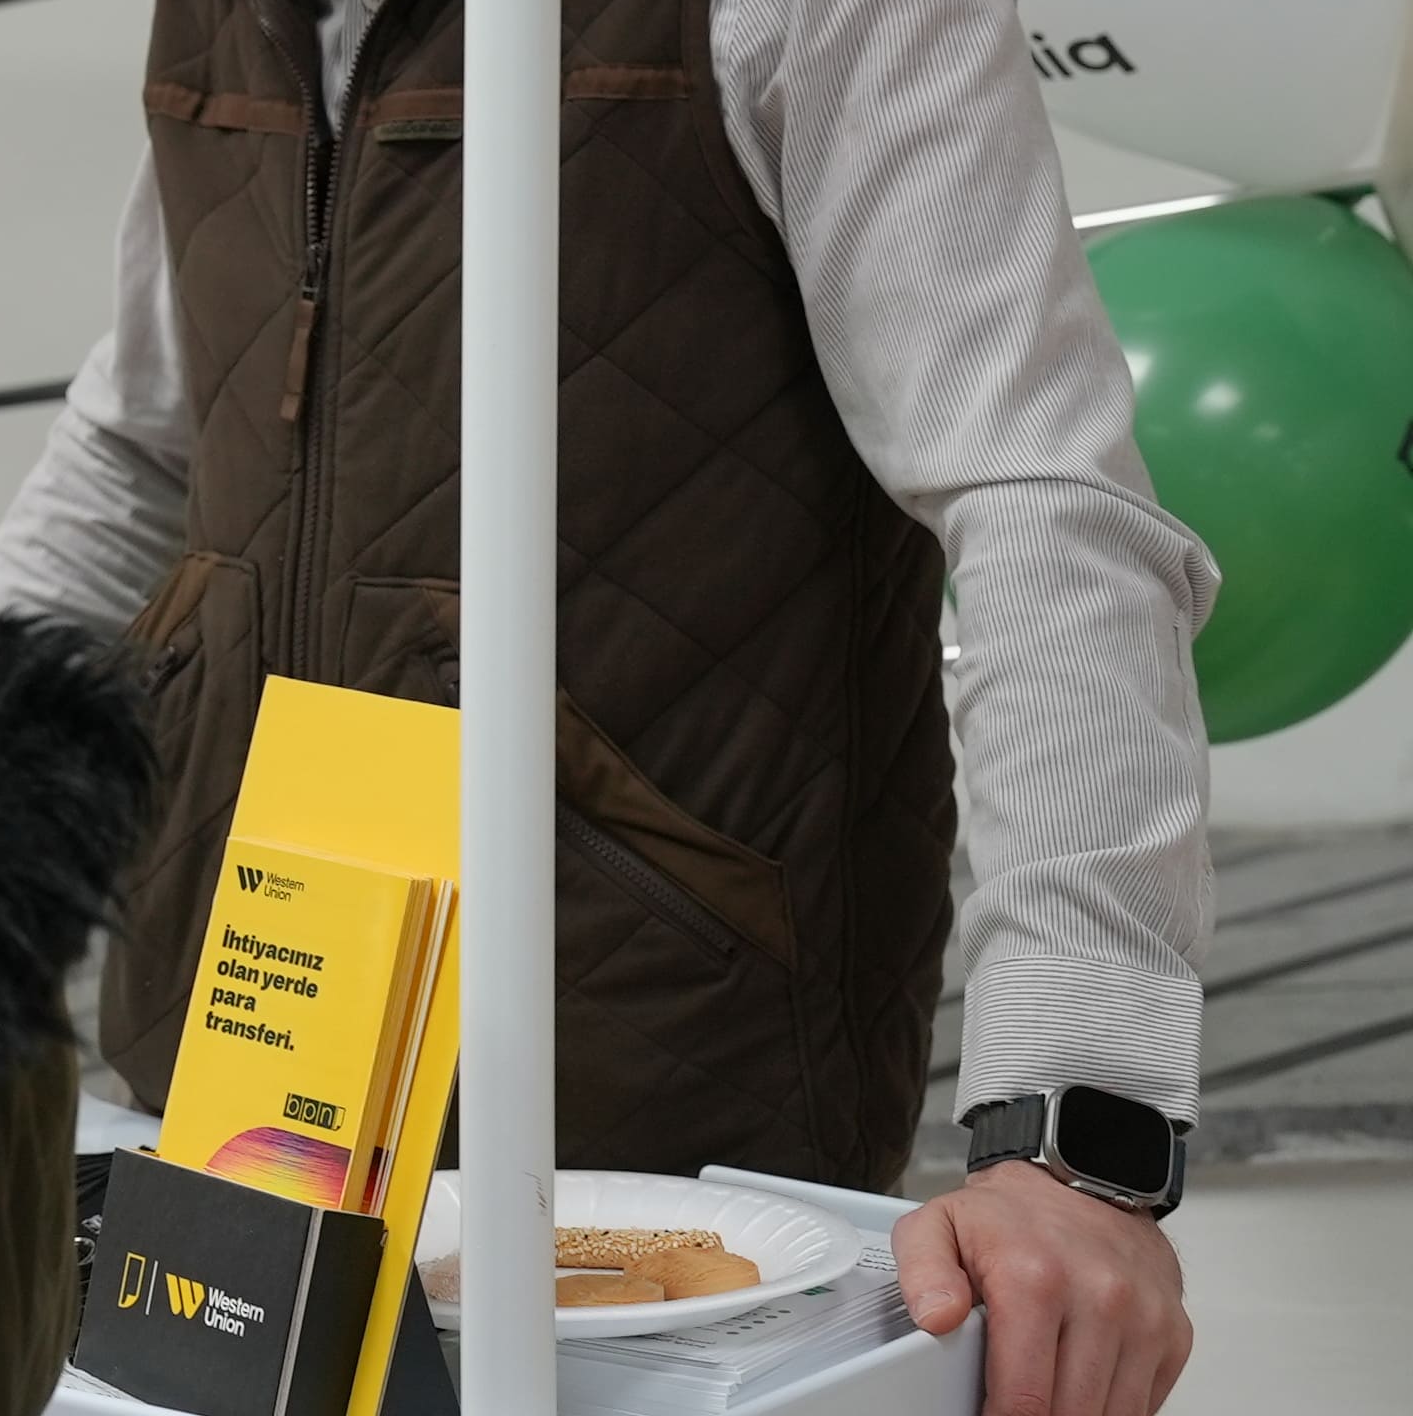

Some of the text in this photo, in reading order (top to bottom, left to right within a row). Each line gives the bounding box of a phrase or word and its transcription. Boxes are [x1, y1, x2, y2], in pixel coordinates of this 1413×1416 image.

[264, 885, 292, 902] Union
[266, 871, 305, 892] Western
[222, 924, 325, 971] İhtiyacınız
[217, 959, 319, 999] olan yerde
[210, 987, 256, 1012] para
[206, 1011, 295, 1052] transferi.
[203, 1306, 245, 1337] Union
[207, 1286, 265, 1324] Western
